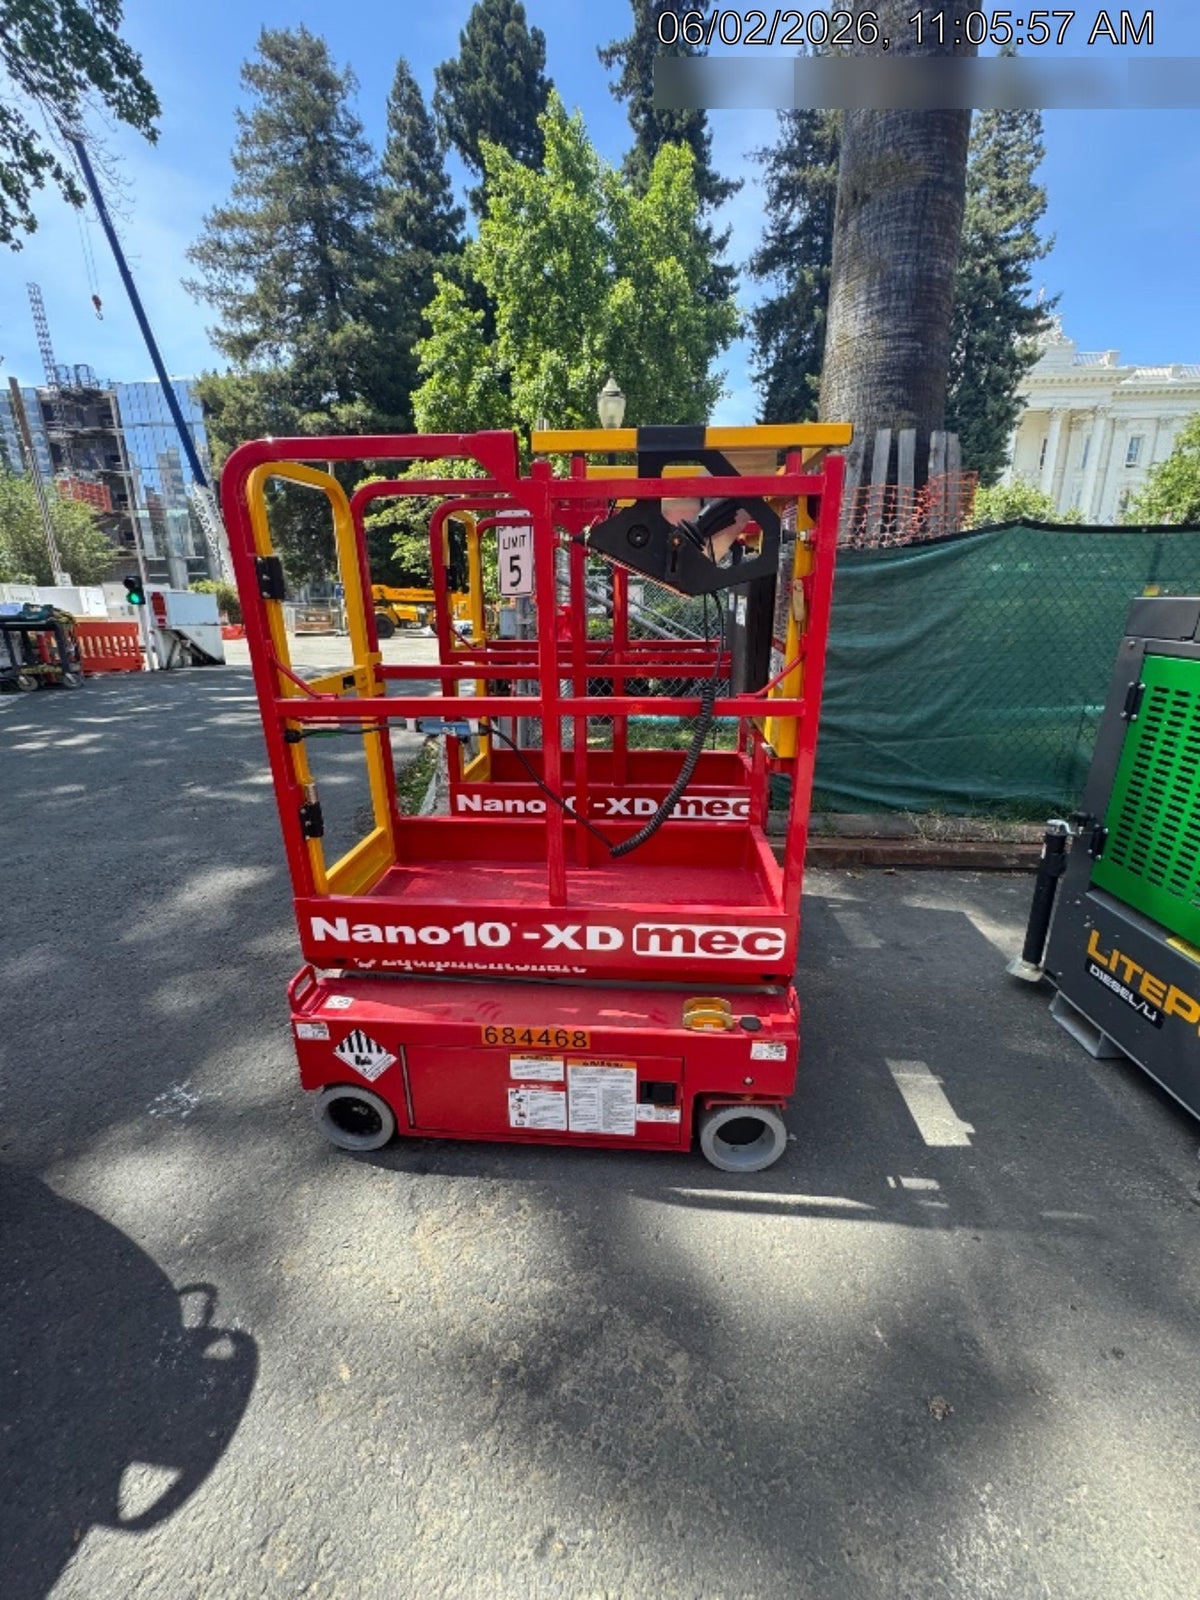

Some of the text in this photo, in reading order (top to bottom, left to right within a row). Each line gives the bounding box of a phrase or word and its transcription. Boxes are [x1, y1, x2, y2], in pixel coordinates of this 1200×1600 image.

[502, 534, 527, 551] LIMIT
[509, 554, 522, 588] 5
[632, 925, 786, 959] mec
[1086, 928, 1200, 1037] LITEP
[484, 1025, 588, 1049] 684468
